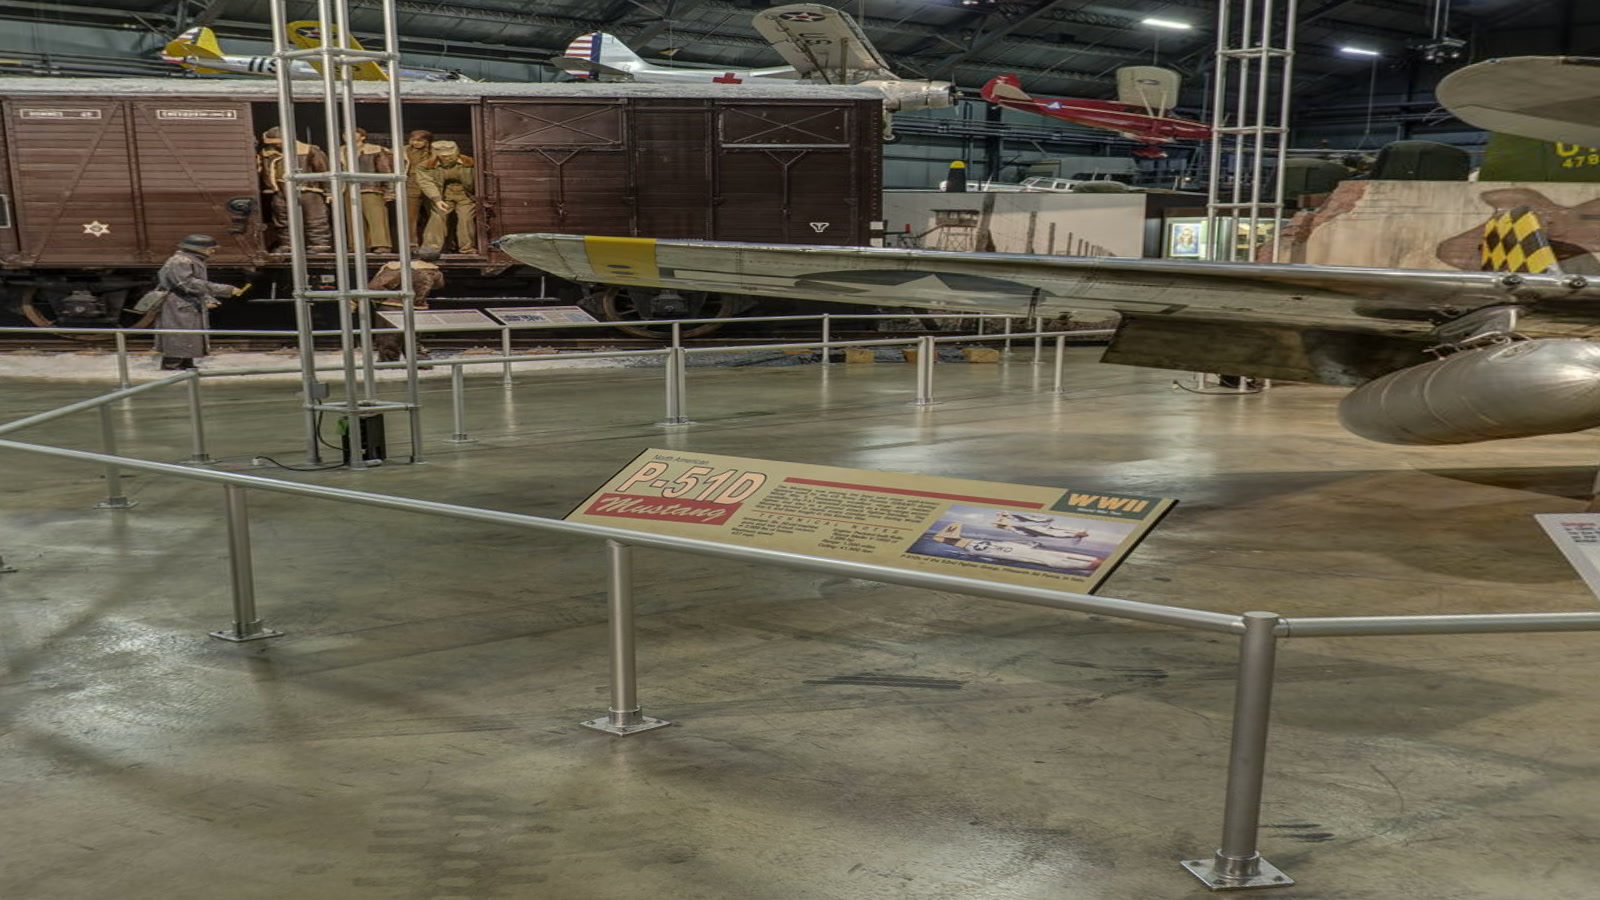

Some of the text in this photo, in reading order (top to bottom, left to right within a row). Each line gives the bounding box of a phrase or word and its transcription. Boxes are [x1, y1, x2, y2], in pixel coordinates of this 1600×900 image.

[615, 461, 768, 505] P-51D
[596, 496, 727, 522] Mustang
[1068, 493, 1149, 512] WWII
